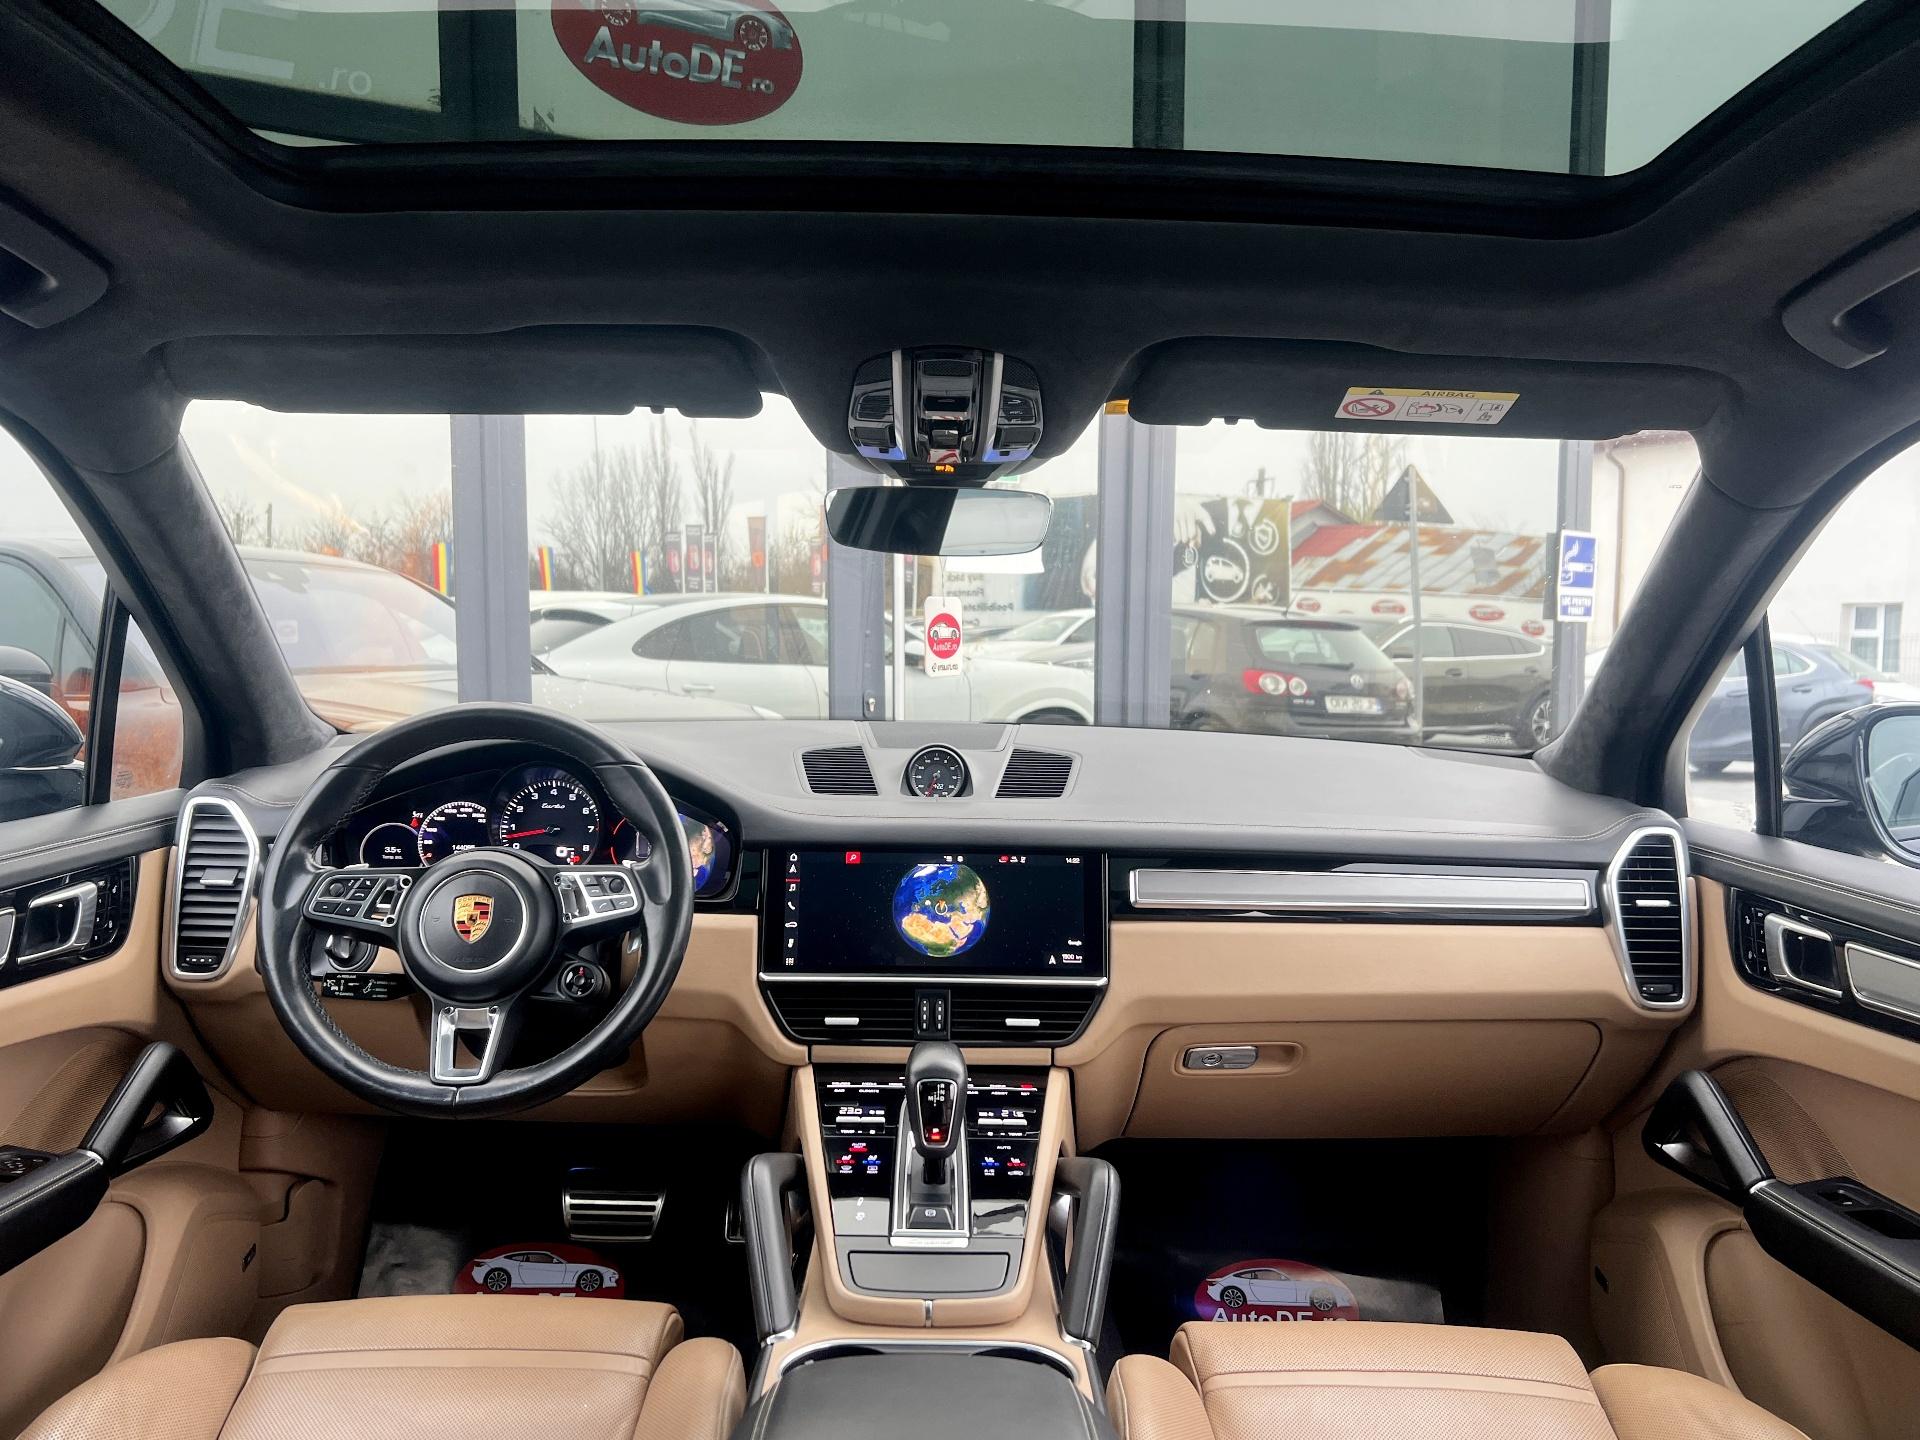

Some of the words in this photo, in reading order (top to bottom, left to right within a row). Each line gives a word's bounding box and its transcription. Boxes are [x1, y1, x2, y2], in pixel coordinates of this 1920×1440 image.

[1420, 390, 1476, 398] AIRBAG
[531, 792, 539, 800] 3
[550, 788, 558, 796] 4
[568, 793, 577, 801] 5
[516, 805, 524, 813] 2
[582, 807, 590, 815] 6
[510, 823, 516, 831] 1
[587, 825, 595, 833] 7
[512, 842, 520, 850] 0
[582, 844, 590, 852] 8
